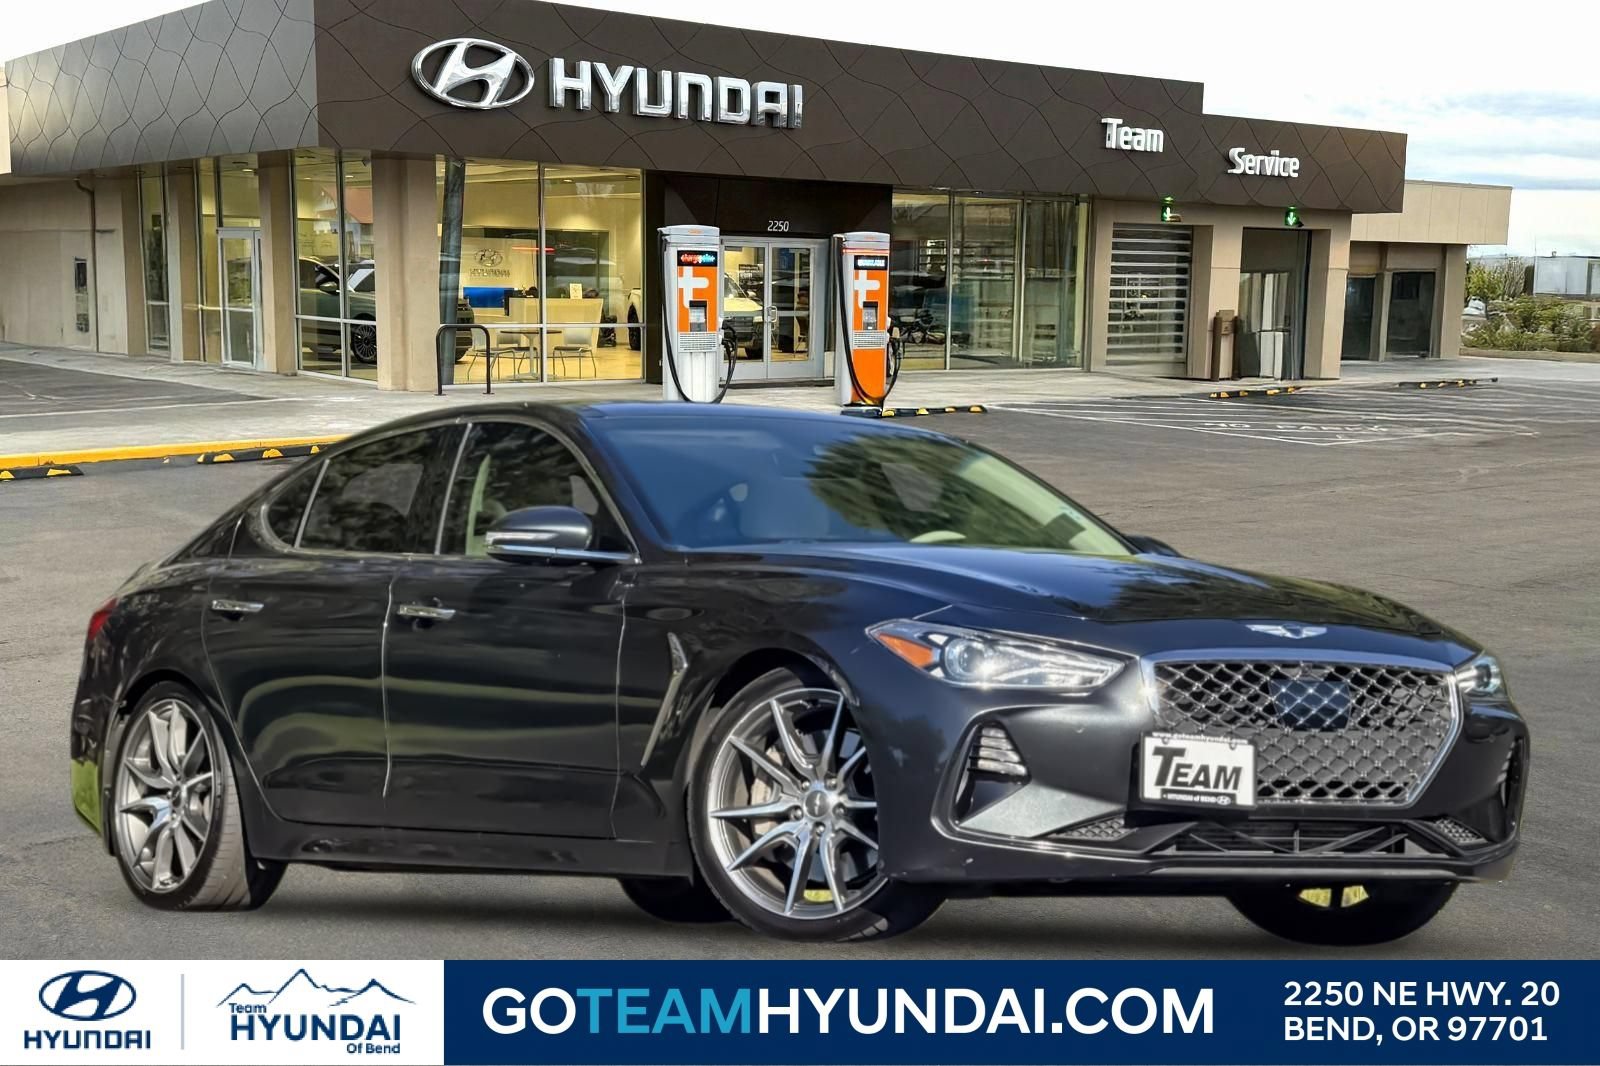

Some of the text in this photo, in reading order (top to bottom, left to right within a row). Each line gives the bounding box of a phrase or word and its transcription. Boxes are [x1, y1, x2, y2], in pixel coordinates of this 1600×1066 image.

[548, 57, 803, 129] HYUNDAI
[1101, 118, 1164, 153] Team
[1227, 147, 1300, 178] Service
[767, 220, 790, 232] 2250
